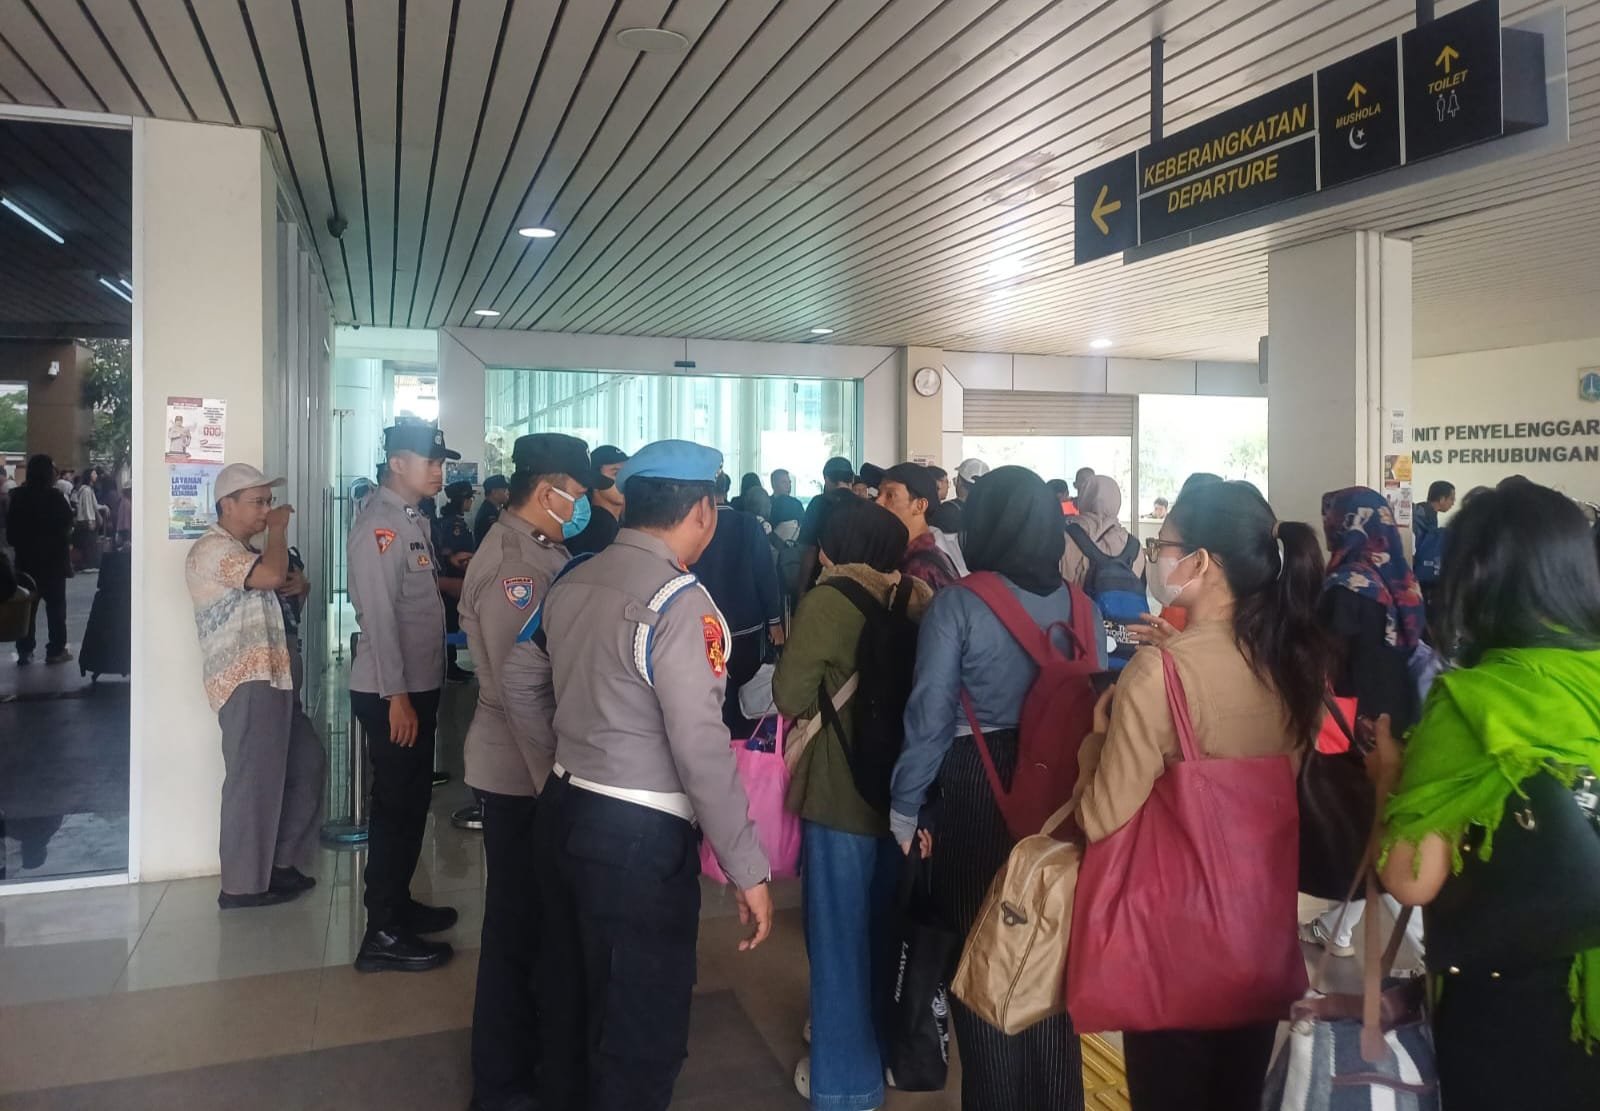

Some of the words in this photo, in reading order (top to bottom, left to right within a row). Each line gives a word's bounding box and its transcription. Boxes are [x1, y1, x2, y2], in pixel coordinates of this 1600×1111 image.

[1427, 69, 1469, 95] TOILET
[1335, 103, 1382, 129] MUSHOLA
[1143, 103, 1308, 189] KEBERANGKATAN
[1167, 153, 1279, 214] DEPARTURE
[1411, 426, 1440, 442] NIT
[1447, 446, 1599, 464] PERHUBUNGAN
